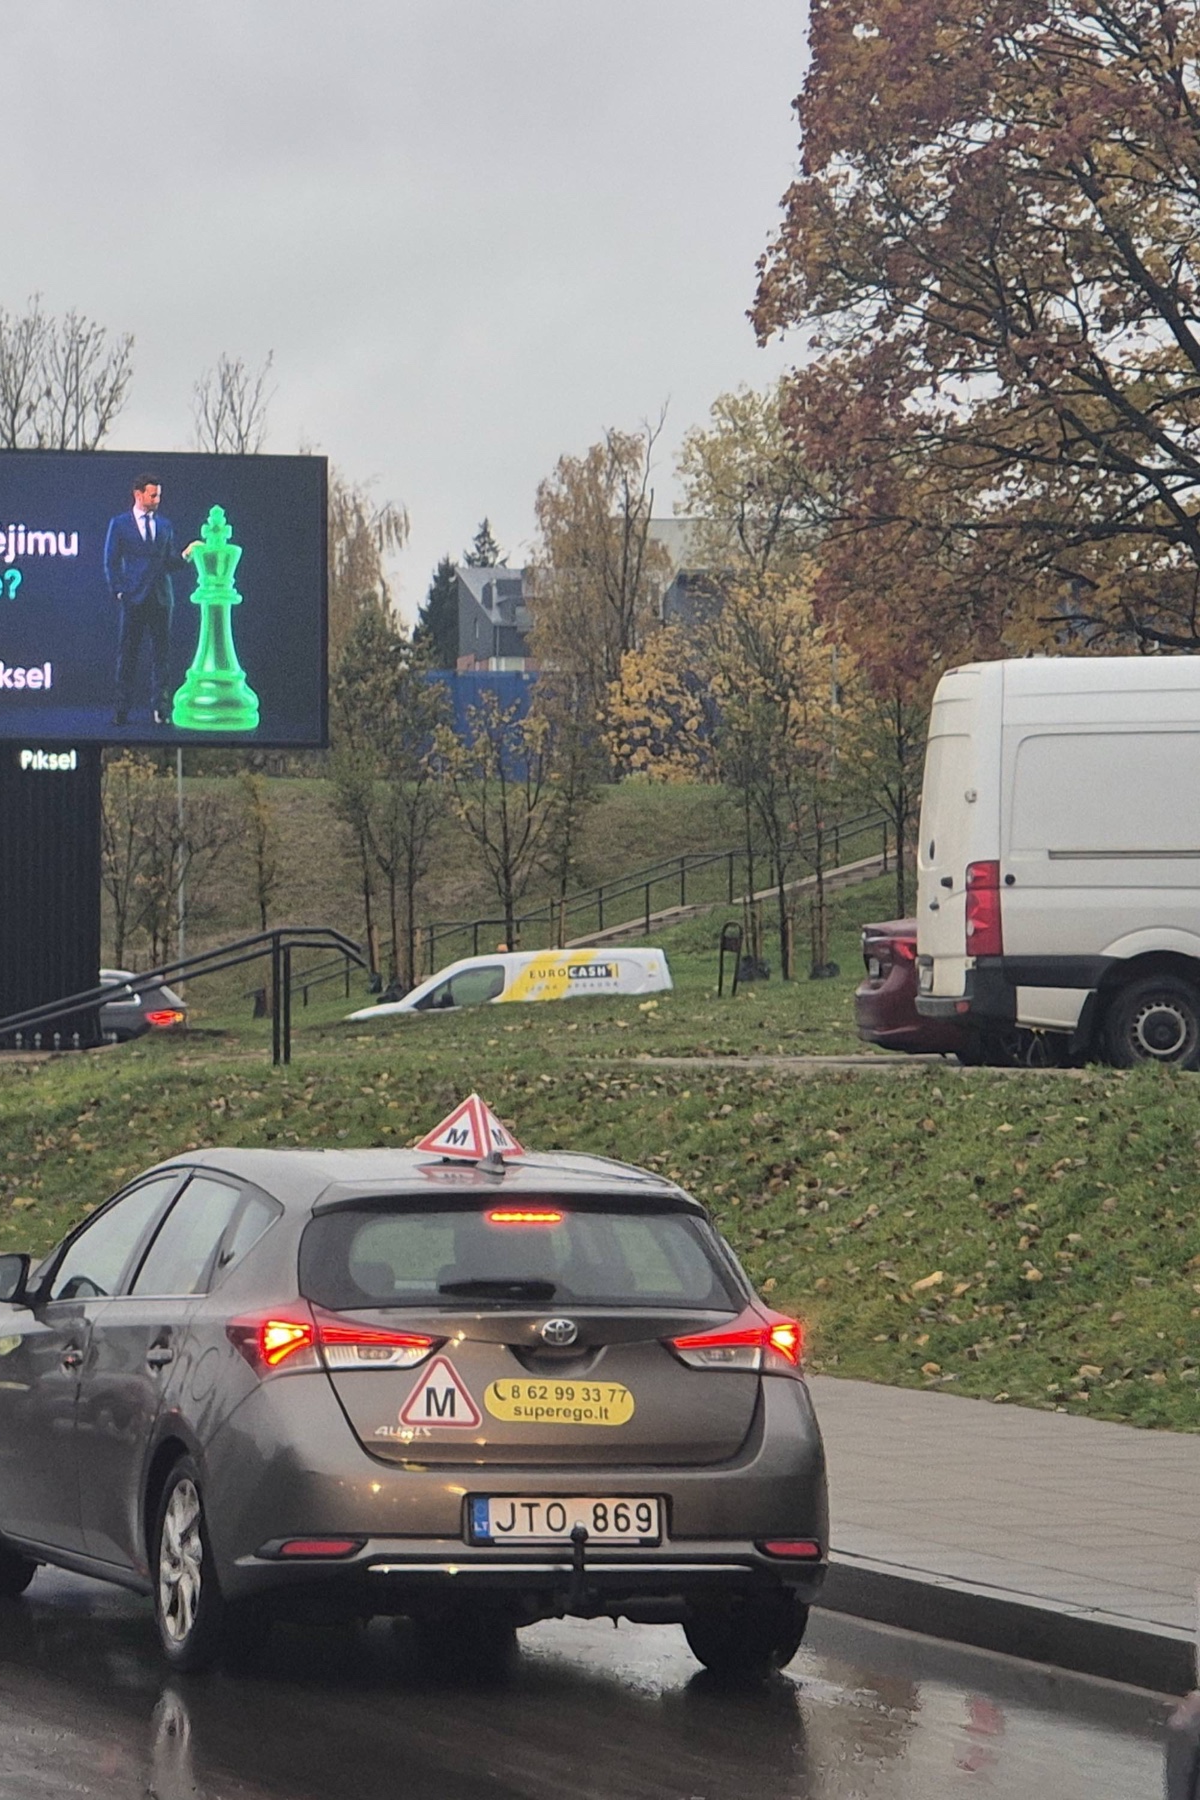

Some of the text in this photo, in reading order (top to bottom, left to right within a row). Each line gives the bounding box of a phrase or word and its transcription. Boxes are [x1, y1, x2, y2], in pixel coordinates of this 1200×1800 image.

[20, 749, 77, 771] Piksel
[445, 1127, 469, 1146] M
[491, 1128, 508, 1146] M
[425, 1387, 456, 1418] M
[511, 1385, 628, 1403] 8 62 99 33 77
[513, 1405, 609, 1421] superego.lt
[474, 1520, 489, 1532] LT
[495, 1502, 652, 1533] JTO 869
